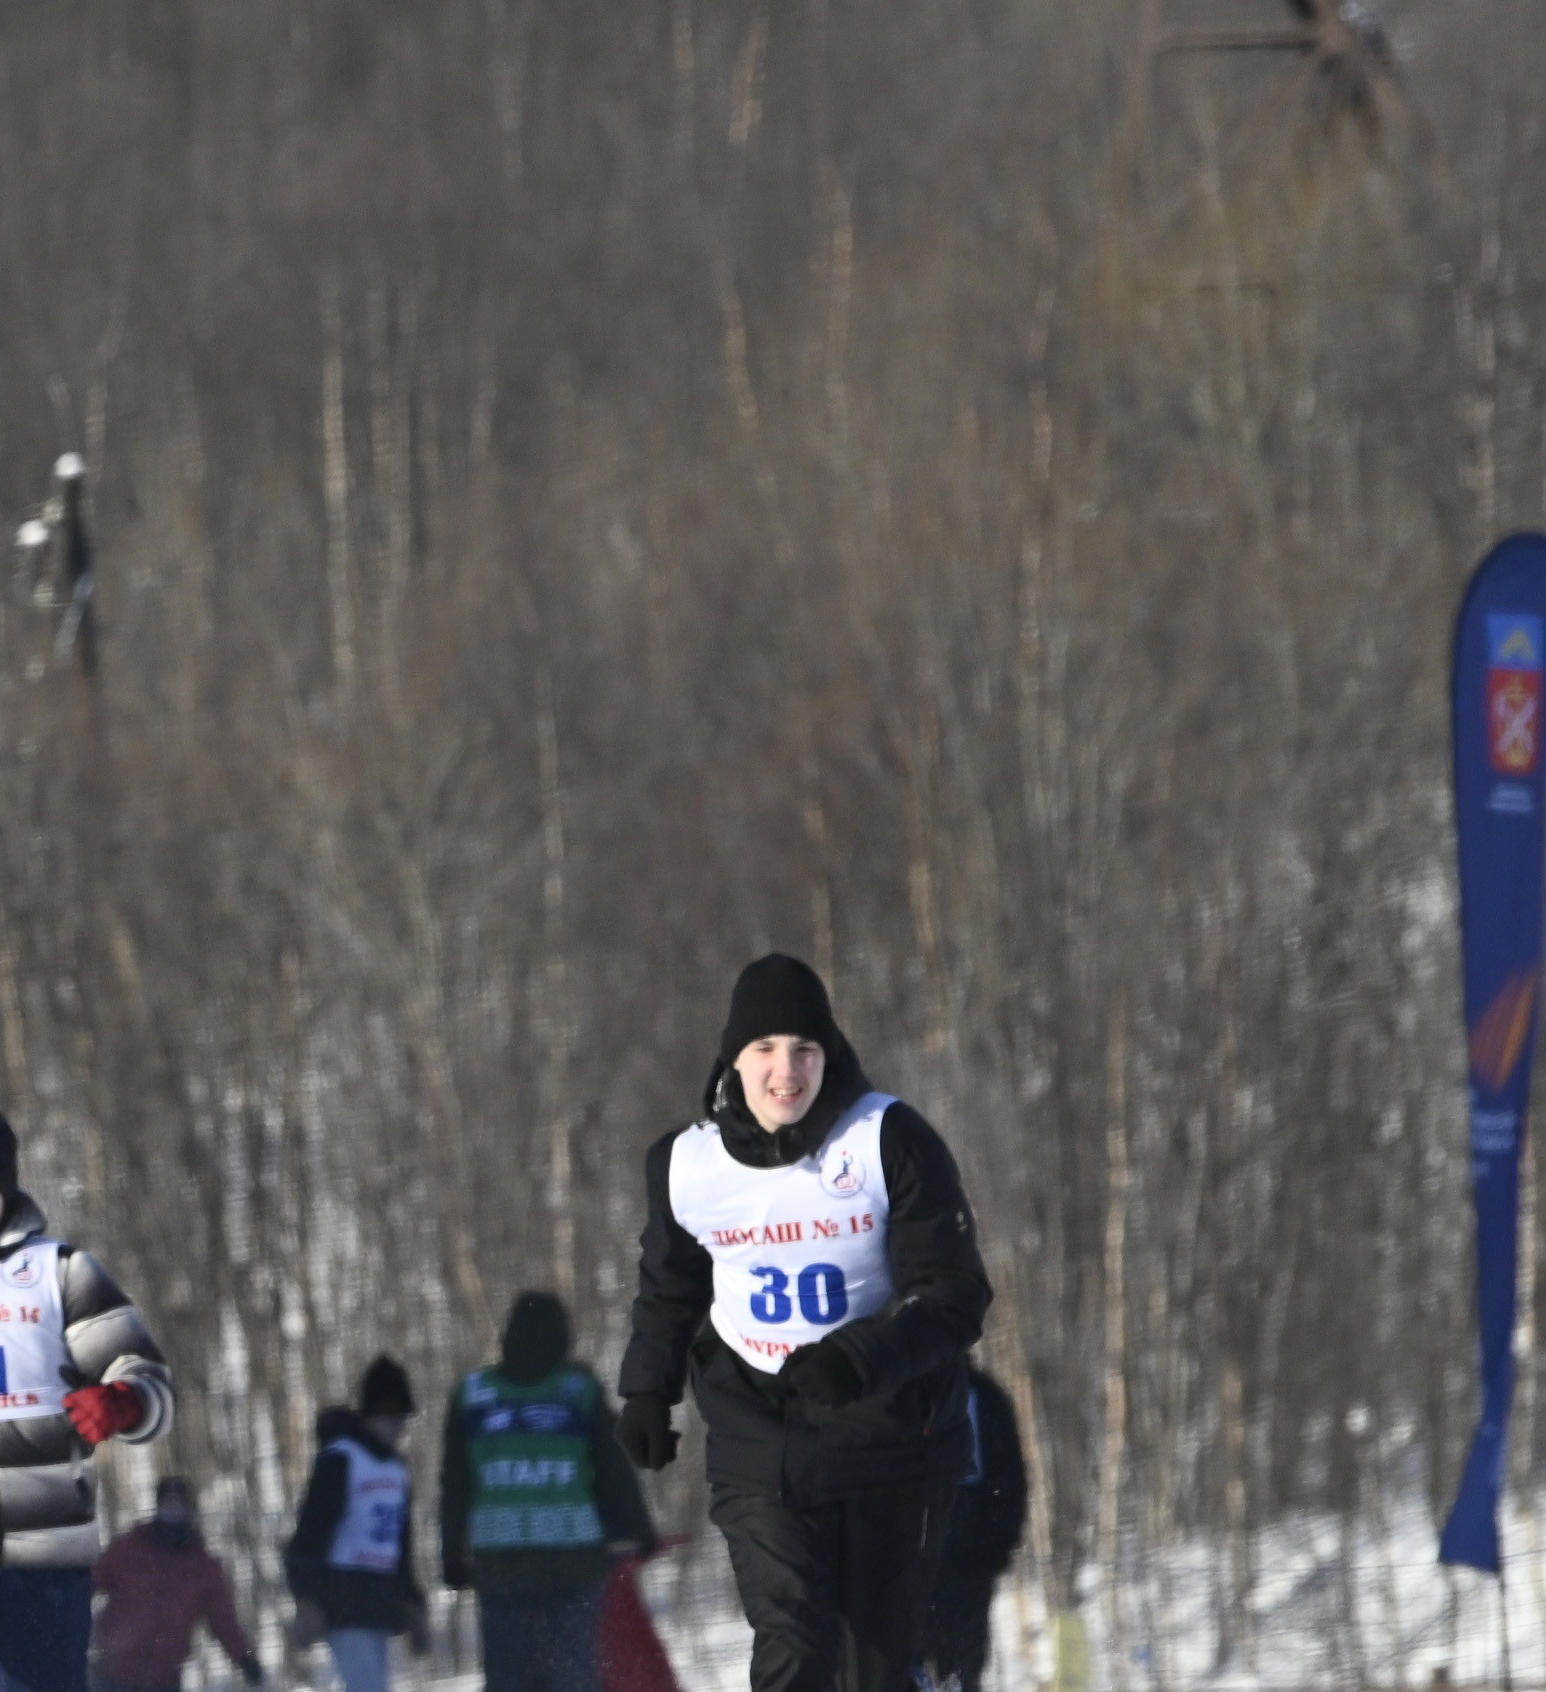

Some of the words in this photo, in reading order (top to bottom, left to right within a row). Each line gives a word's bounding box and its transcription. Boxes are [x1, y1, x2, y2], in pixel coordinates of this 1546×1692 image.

[813, 1209, 841, 1240] №
[850, 1203, 875, 1235] 15
[749, 1262, 850, 1326] 30
